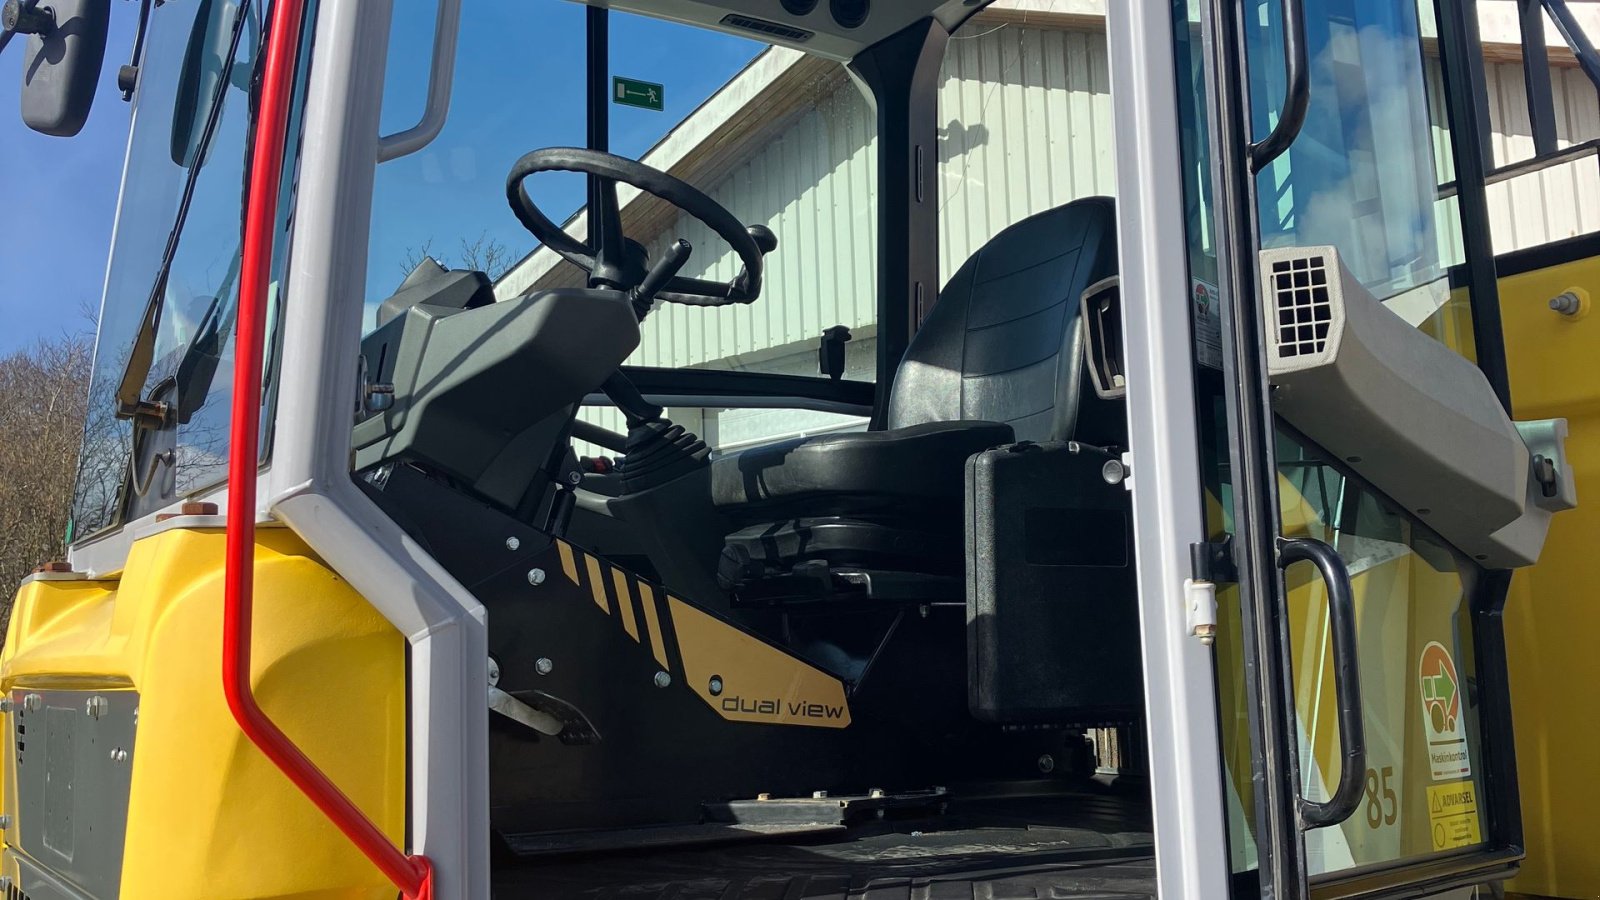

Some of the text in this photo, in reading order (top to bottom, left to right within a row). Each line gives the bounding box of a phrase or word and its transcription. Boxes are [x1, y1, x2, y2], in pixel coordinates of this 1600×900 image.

[722, 696, 843, 718] dual view
[1431, 750, 1467, 763] Maskinkontrol
[1366, 766, 1397, 829] 85
[1442, 791, 1473, 807] ADVARSEL
